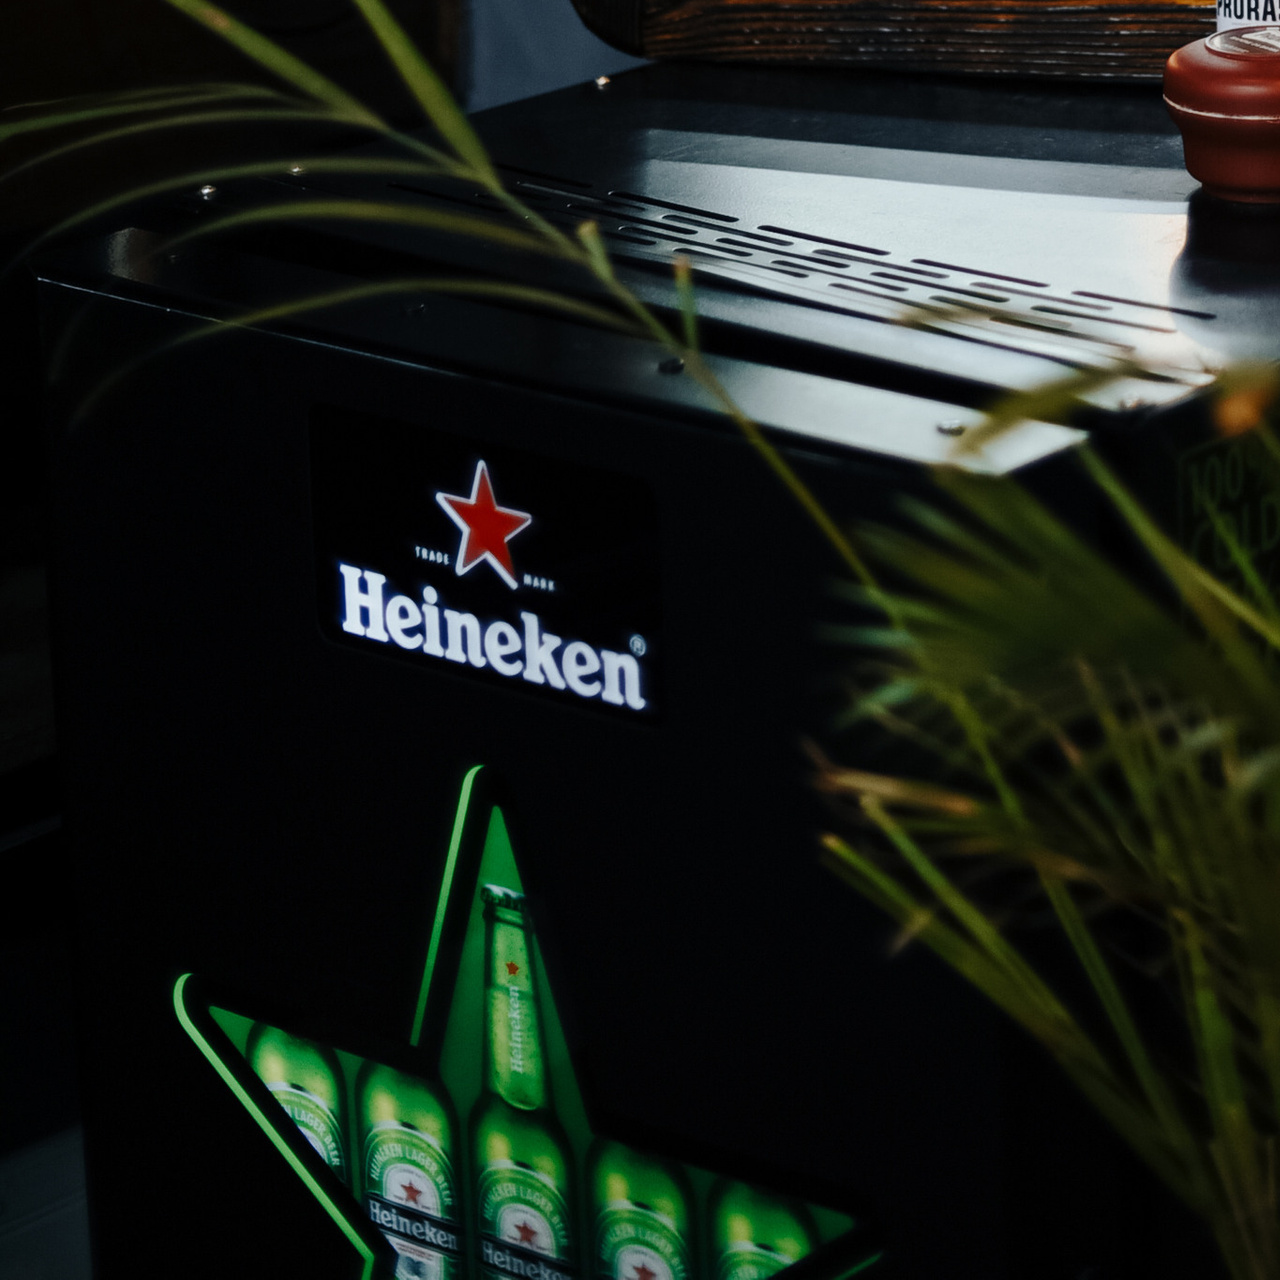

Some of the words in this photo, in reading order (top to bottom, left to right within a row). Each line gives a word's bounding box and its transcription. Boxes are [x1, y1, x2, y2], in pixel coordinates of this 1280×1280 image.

[415, 546, 449, 565] TRADE
[524, 574, 555, 591] MARK
[508, 986, 523, 1074] Heineken
[405, 1146, 439, 1176] LAGER
[369, 1199, 458, 1250] Heineken
